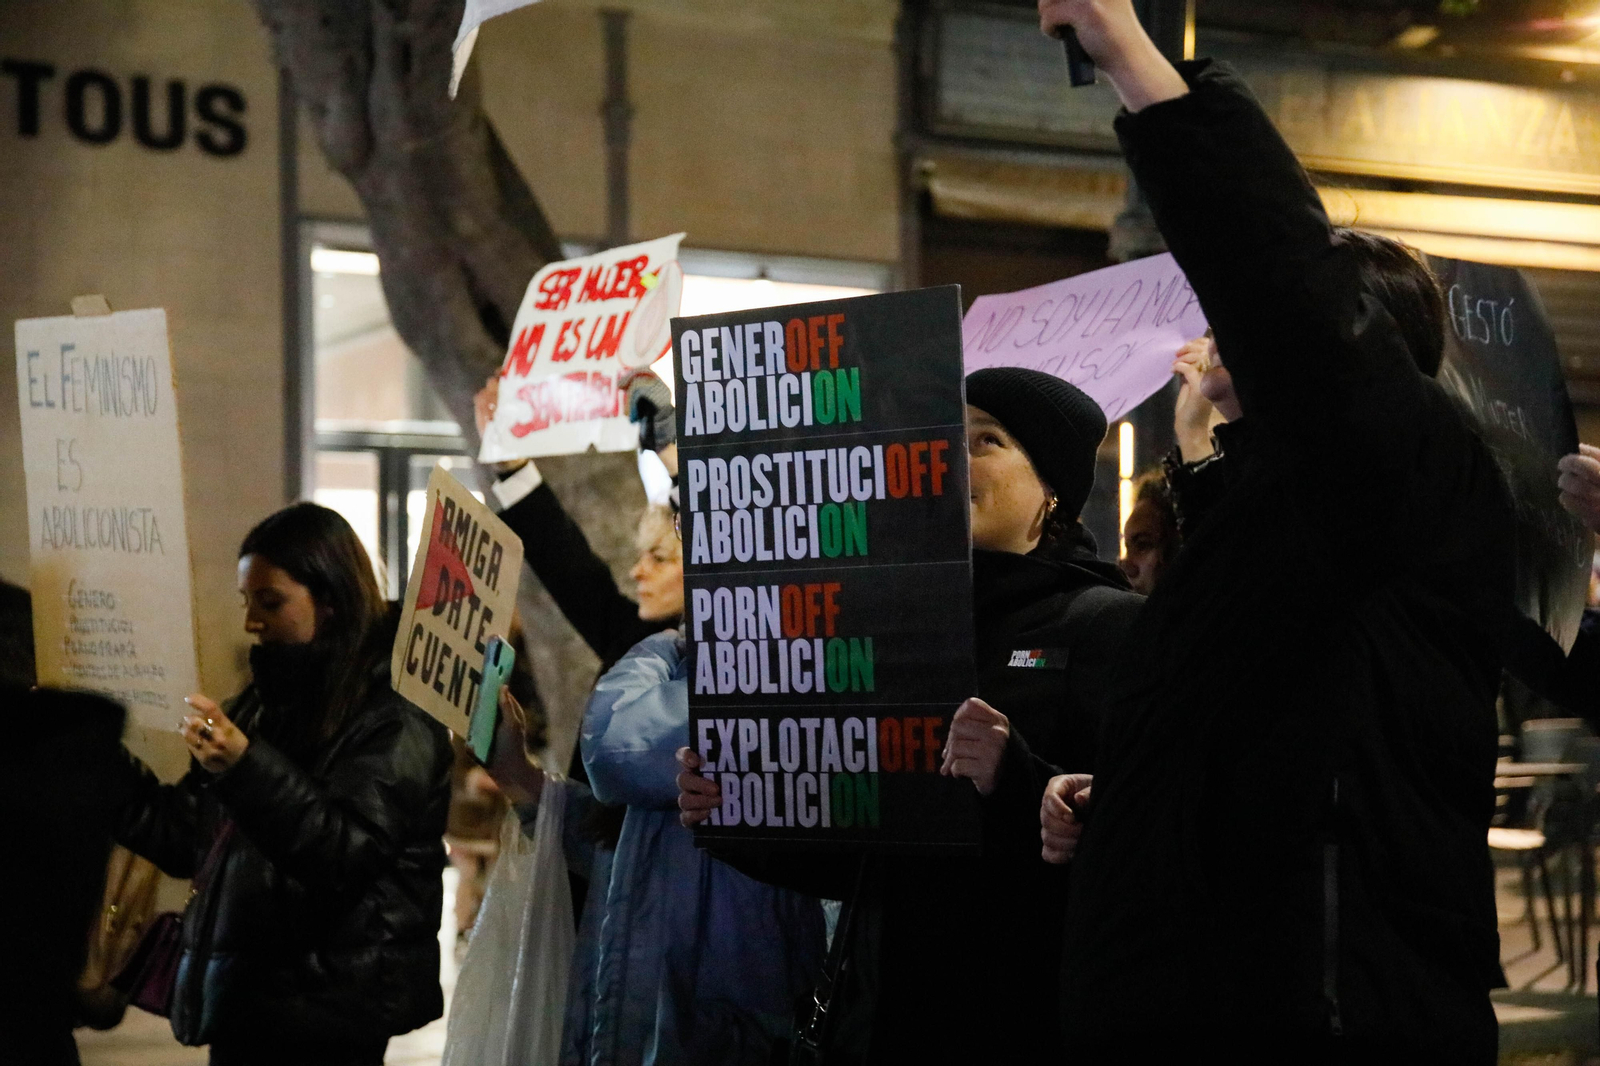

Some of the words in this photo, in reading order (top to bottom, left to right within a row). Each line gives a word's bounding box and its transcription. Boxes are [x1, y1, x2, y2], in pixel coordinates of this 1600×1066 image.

[1, 60, 248, 157] TOUS
[534, 266, 582, 311] SER
[500, 322, 546, 379] NO
[550, 318, 585, 362] ES
[585, 311, 633, 361] UN
[680, 313, 845, 383] GENEROFF
[964, 305, 1026, 353] NO
[27, 351, 55, 408] EL
[60, 343, 158, 418] FEMINISMO
[684, 367, 862, 437] ABOLICION
[56, 437, 82, 493] ES
[687, 440, 949, 512] PROSTITUCIOFF
[40, 506, 165, 556] ABOLICIONISTA
[691, 502, 868, 565] ABOLICION
[432, 564, 494, 656] DATE
[692, 582, 842, 641] PORNOFF
[405, 623, 483, 717] CUENT
[695, 637, 875, 695] ABOLICION
[697, 717, 943, 773] EXPLOTACIOFF
